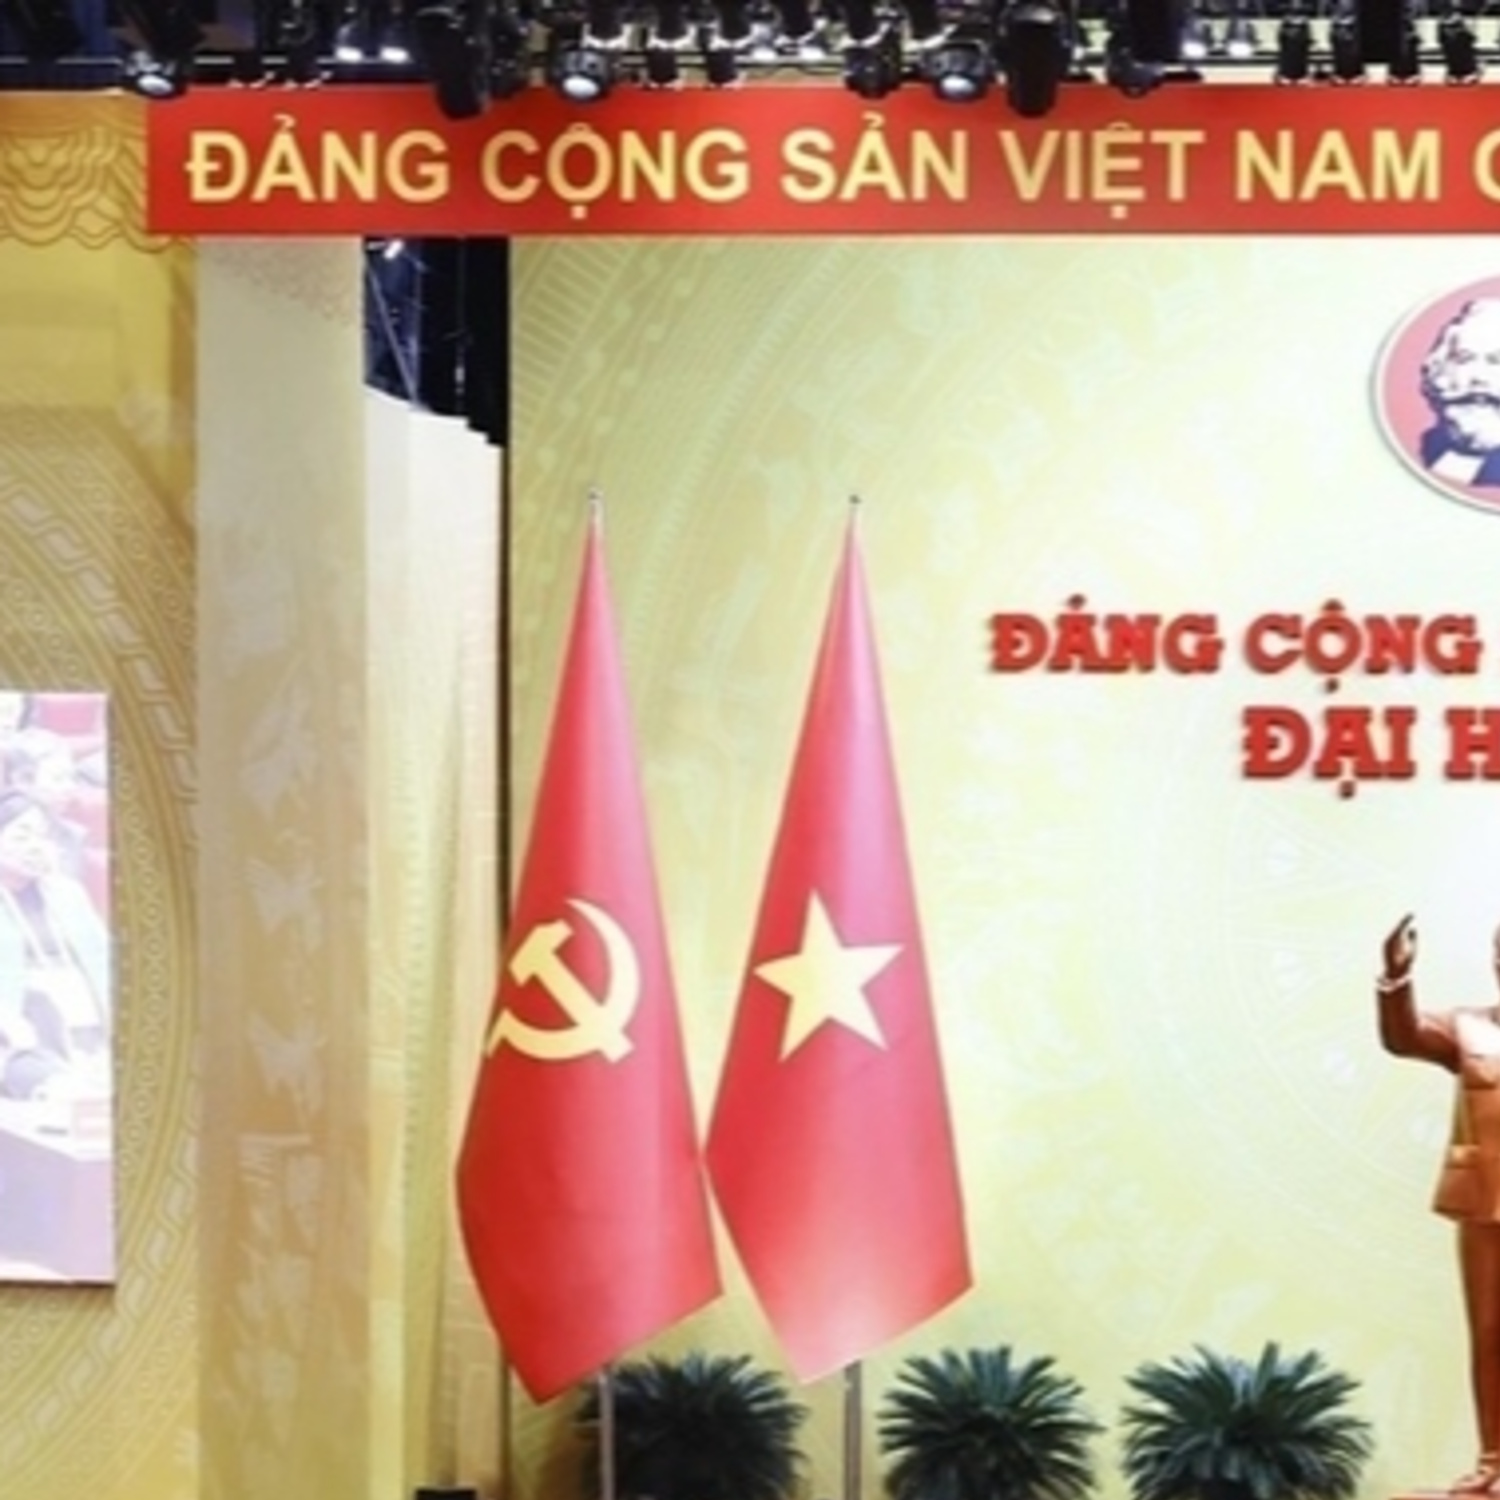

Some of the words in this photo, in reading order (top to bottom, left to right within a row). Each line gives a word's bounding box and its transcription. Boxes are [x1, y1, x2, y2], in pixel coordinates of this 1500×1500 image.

[184, 114, 449, 203] ĐẢNG
[481, 122, 751, 220] CỘNG
[779, 111, 968, 203] SẢN
[997, 121, 1206, 220] VIỆT
[1234, 128, 1442, 203] NAM
[990, 594, 1226, 674] ĐẢNG
[1244, 599, 1484, 693] CỘNG
[1242, 706, 1417, 799] ĐẠI
